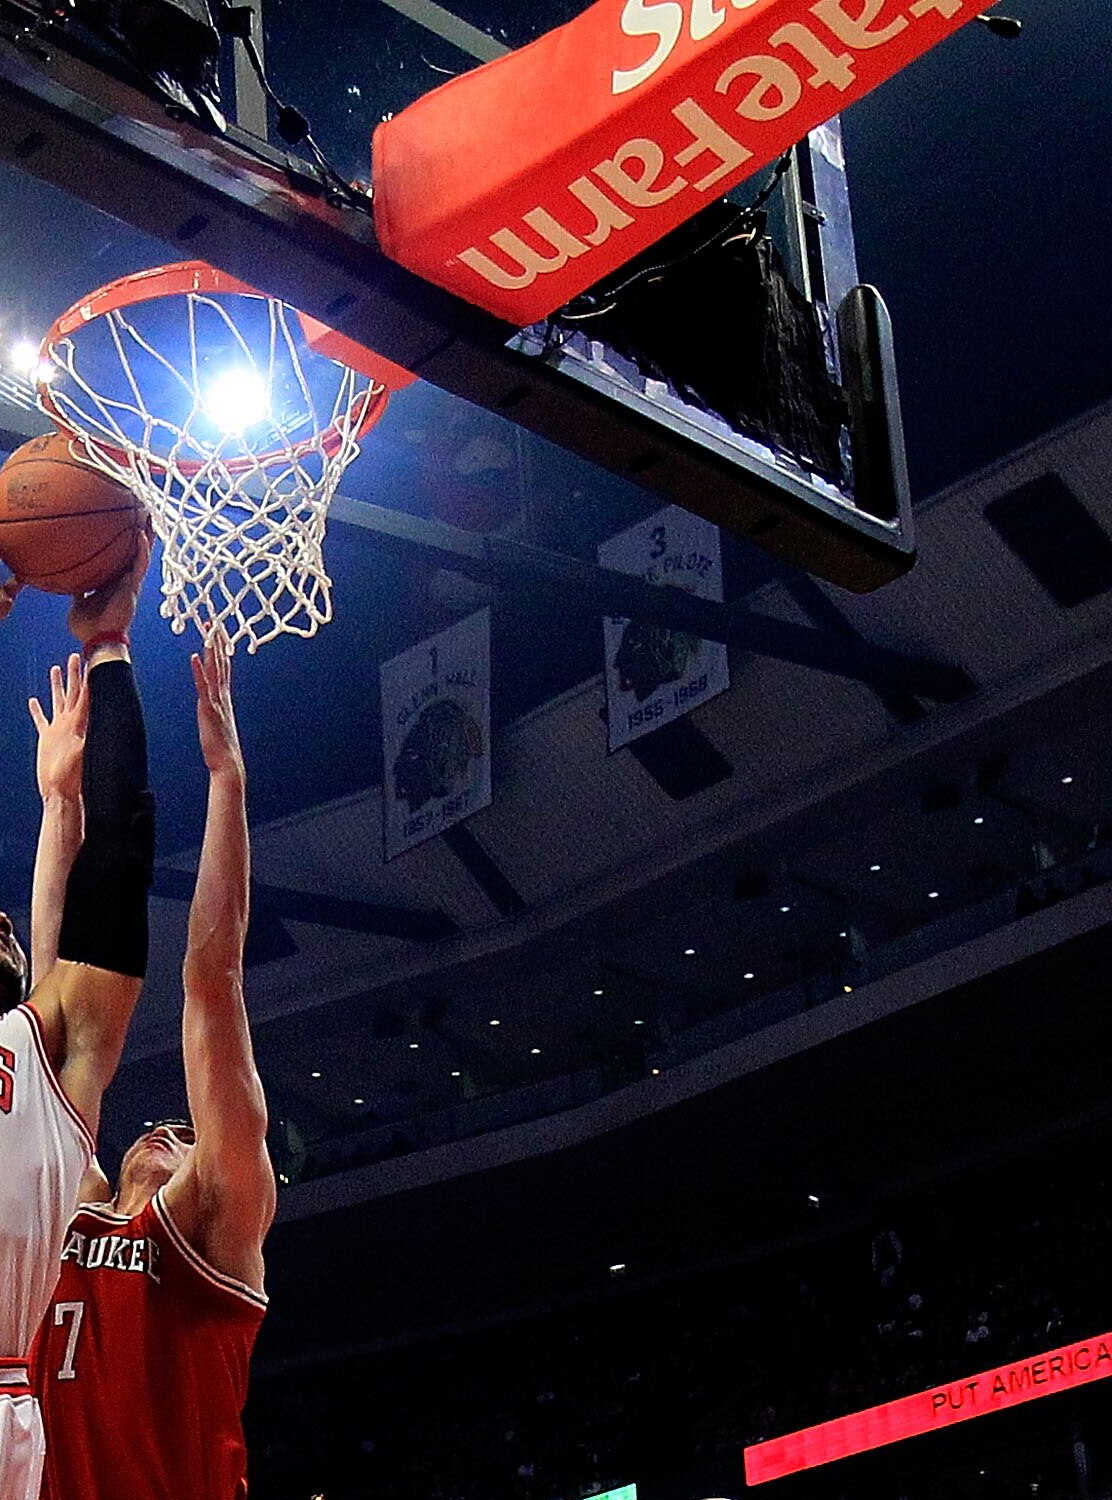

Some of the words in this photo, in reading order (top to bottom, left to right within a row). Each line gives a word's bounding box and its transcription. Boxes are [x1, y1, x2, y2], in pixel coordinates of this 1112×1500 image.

[457, 97, 754, 290] Farm
[650, 526, 666, 560] 3
[54, 1302, 84, 1380] 7
[931, 1381, 979, 1417] PUT
[991, 1342, 1112, 1400] AMERICA
